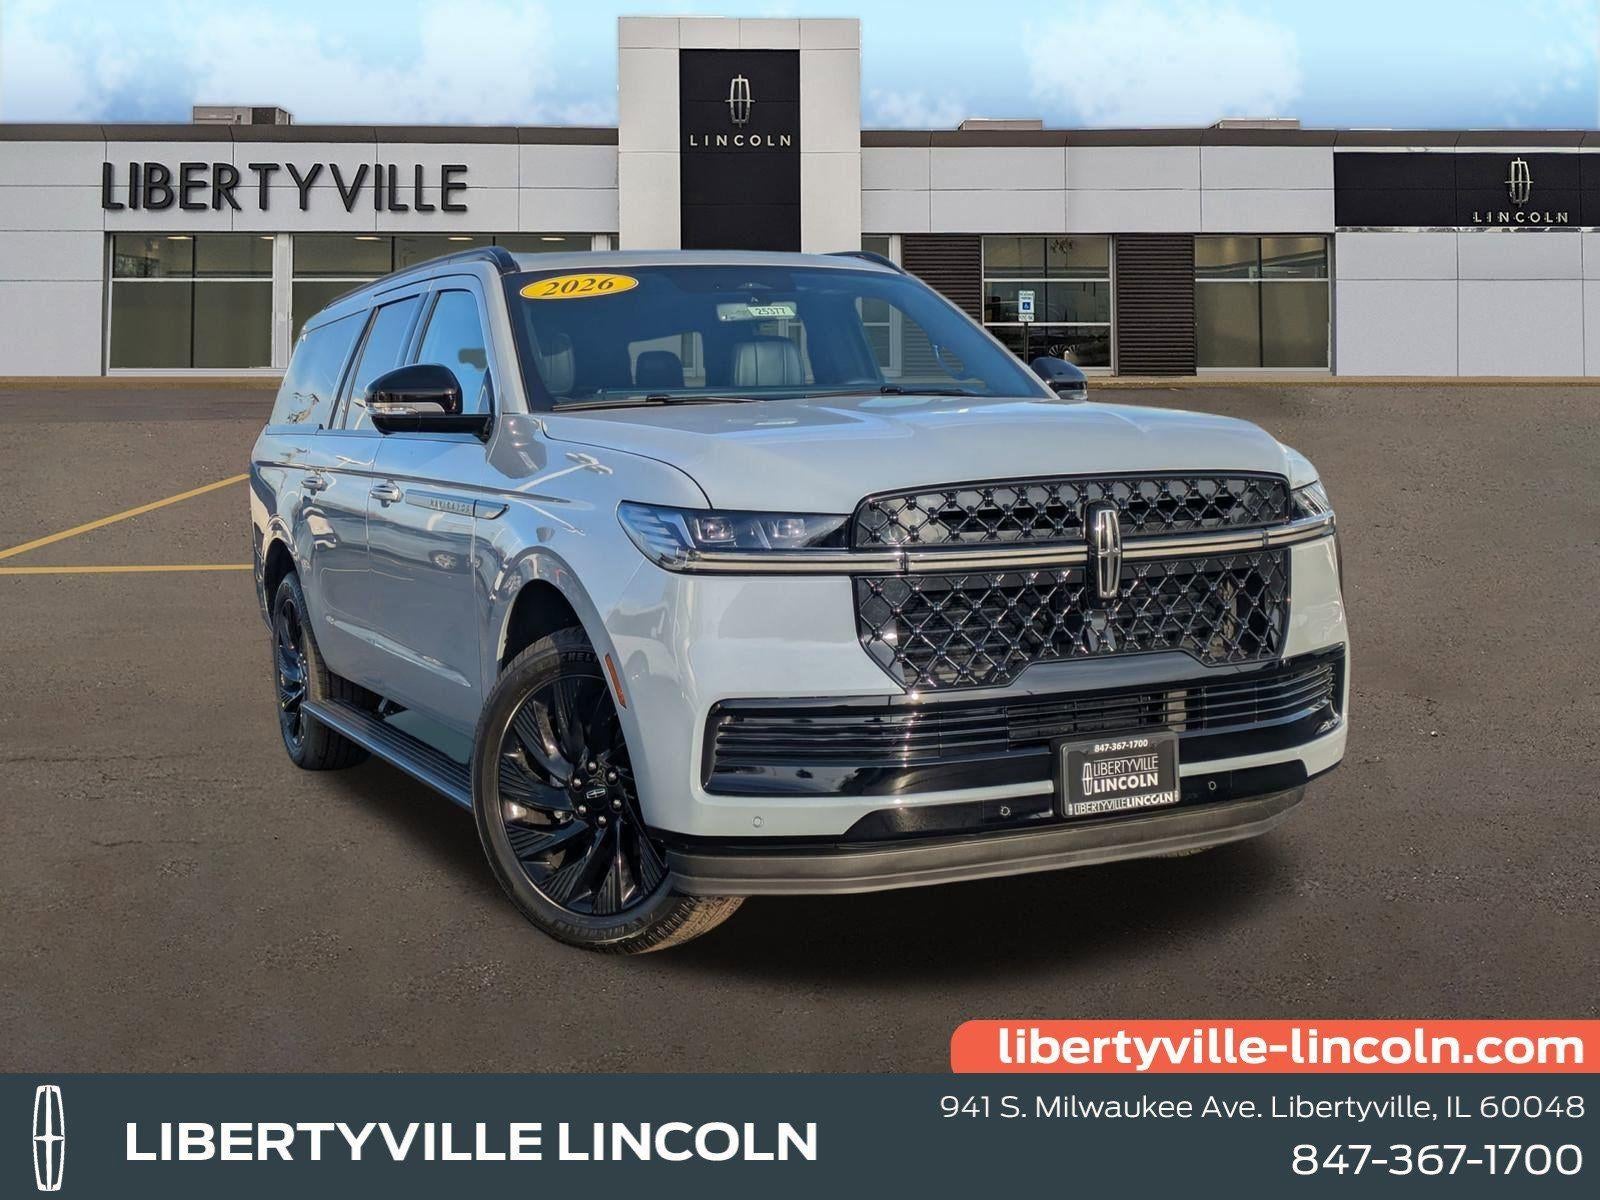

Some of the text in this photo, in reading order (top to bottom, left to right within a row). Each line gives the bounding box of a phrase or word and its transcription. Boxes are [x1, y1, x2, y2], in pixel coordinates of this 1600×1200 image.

[690, 134, 791, 147] LINCOLN
[101, 161, 468, 213] LIBERTYVILLE
[1473, 211, 1568, 223] LINCOLN
[540, 276, 617, 297] 2026
[1094, 738, 1149, 753] 847-367-1700
[1093, 755, 1159, 776] LIBERTYVILLE
[1093, 772, 1159, 793] LINCOLN
